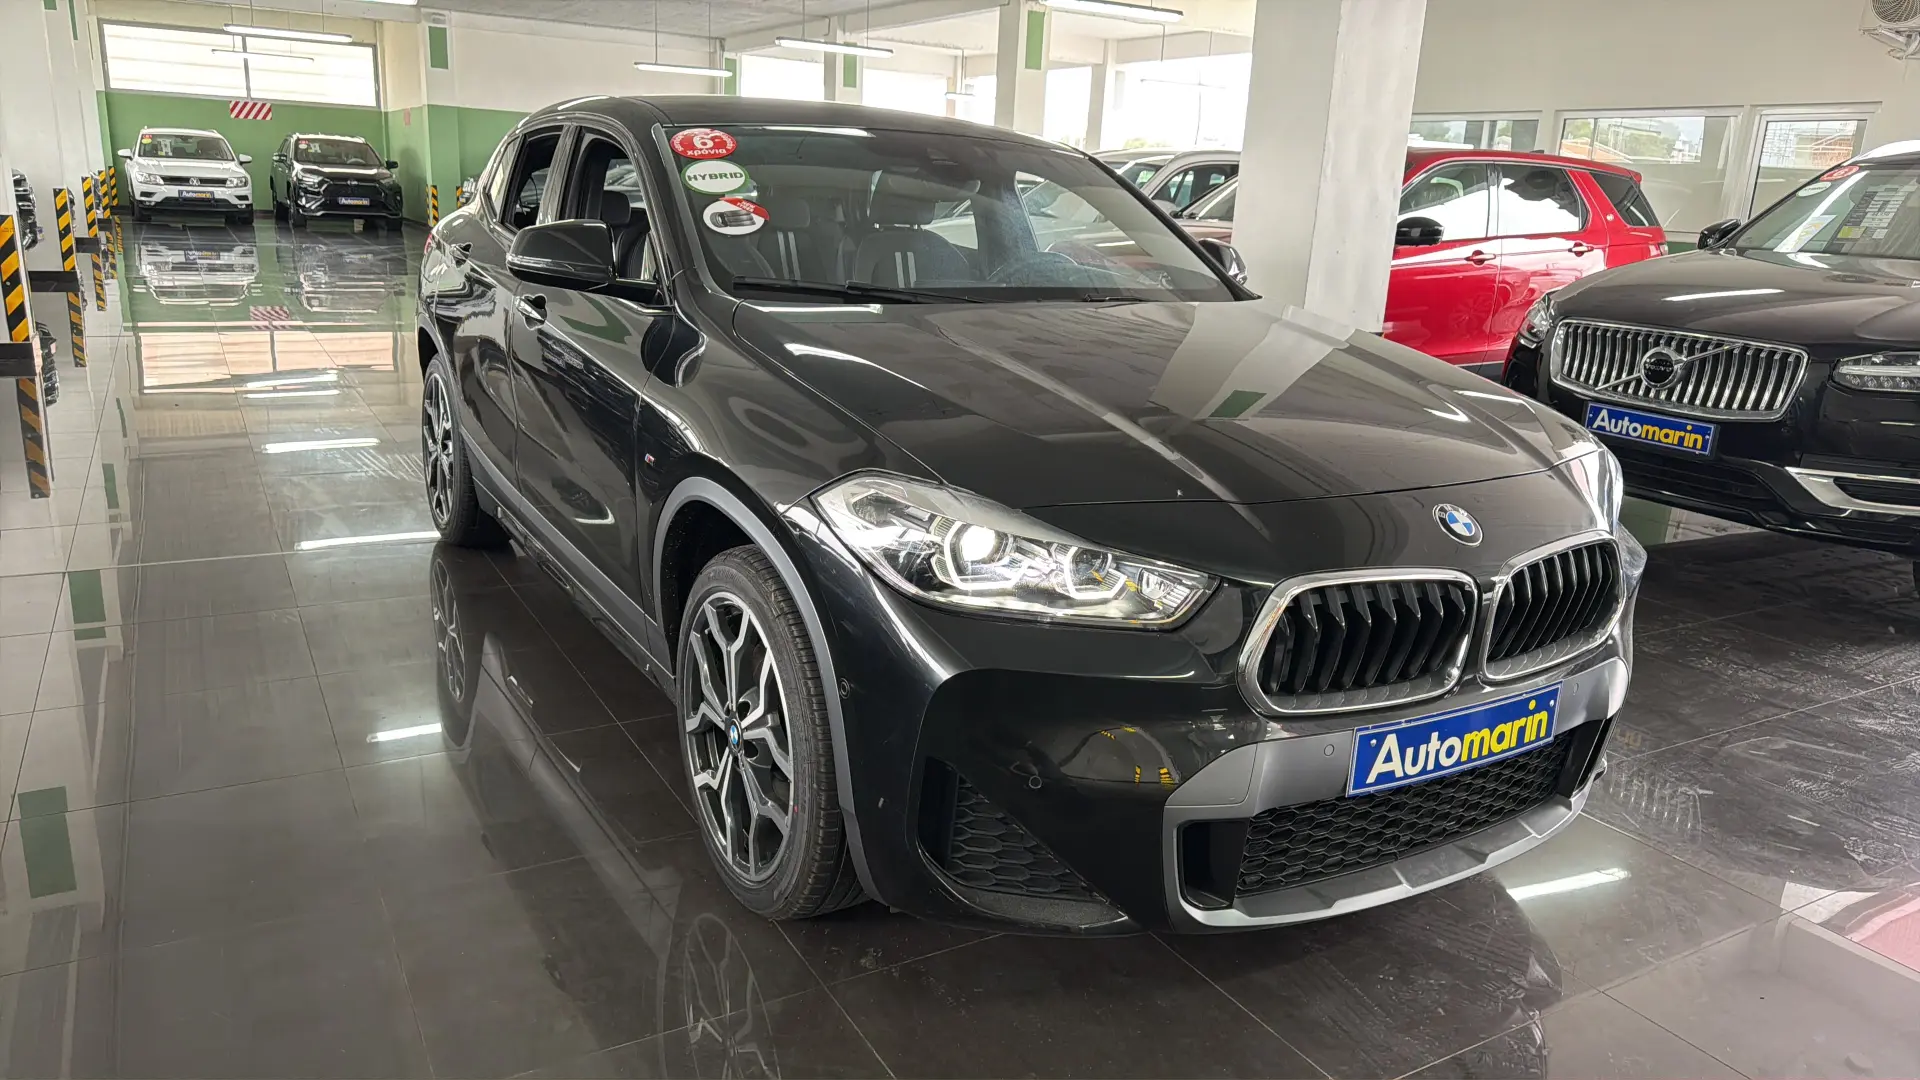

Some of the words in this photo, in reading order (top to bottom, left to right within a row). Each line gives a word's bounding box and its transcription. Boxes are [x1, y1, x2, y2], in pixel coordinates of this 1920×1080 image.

[692, 134, 714, 149] 6
[686, 148, 727, 156] χρόνια
[687, 171, 744, 182] HYBRID
[1592, 408, 1703, 450] Automarin
[1365, 699, 1549, 784] Automarin
